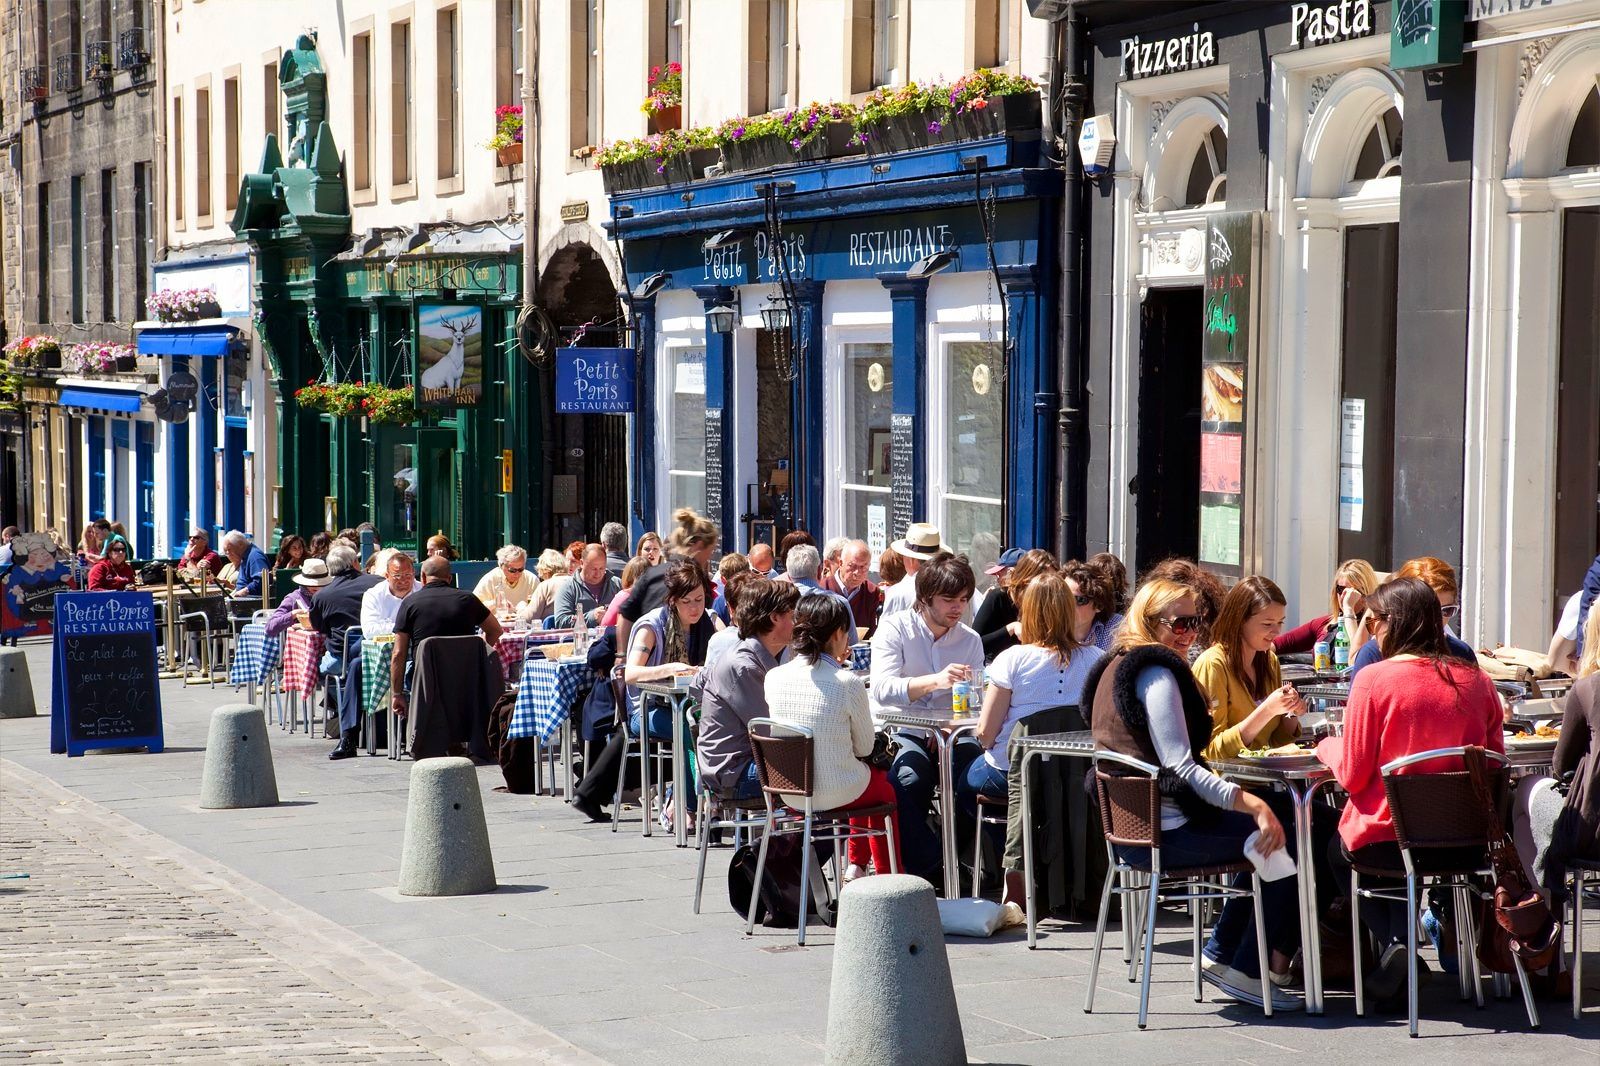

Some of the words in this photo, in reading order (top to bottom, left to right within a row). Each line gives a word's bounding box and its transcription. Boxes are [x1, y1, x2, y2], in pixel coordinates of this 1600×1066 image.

[1290, 0, 1371, 46] Pasta
[1120, 22, 1214, 76] Pizzeria
[701, 238, 742, 280] Petit
[754, 230, 806, 280] Paris
[850, 225, 949, 266] RESTAURANT
[366, 262, 382, 291] THE
[415, 260, 444, 290] HART
[448, 259, 467, 288] INN
[573, 358, 619, 380] Petit
[424, 388, 452, 401] WHITE
[455, 388, 475, 396] HART
[456, 395, 476, 404] INN
[574, 378, 618, 400] Paris
[561, 402, 631, 410] RESTAURANT
[63, 600, 105, 622] Petit
[106, 598, 149, 621] Paris
[64, 621, 151, 633] RESTAURANT
[67, 639, 85, 662] Le
[91, 643, 114, 665] plat
[122, 646, 138, 658] du
[78, 673, 102, 690] jour
[118, 666, 145, 686] coffee
